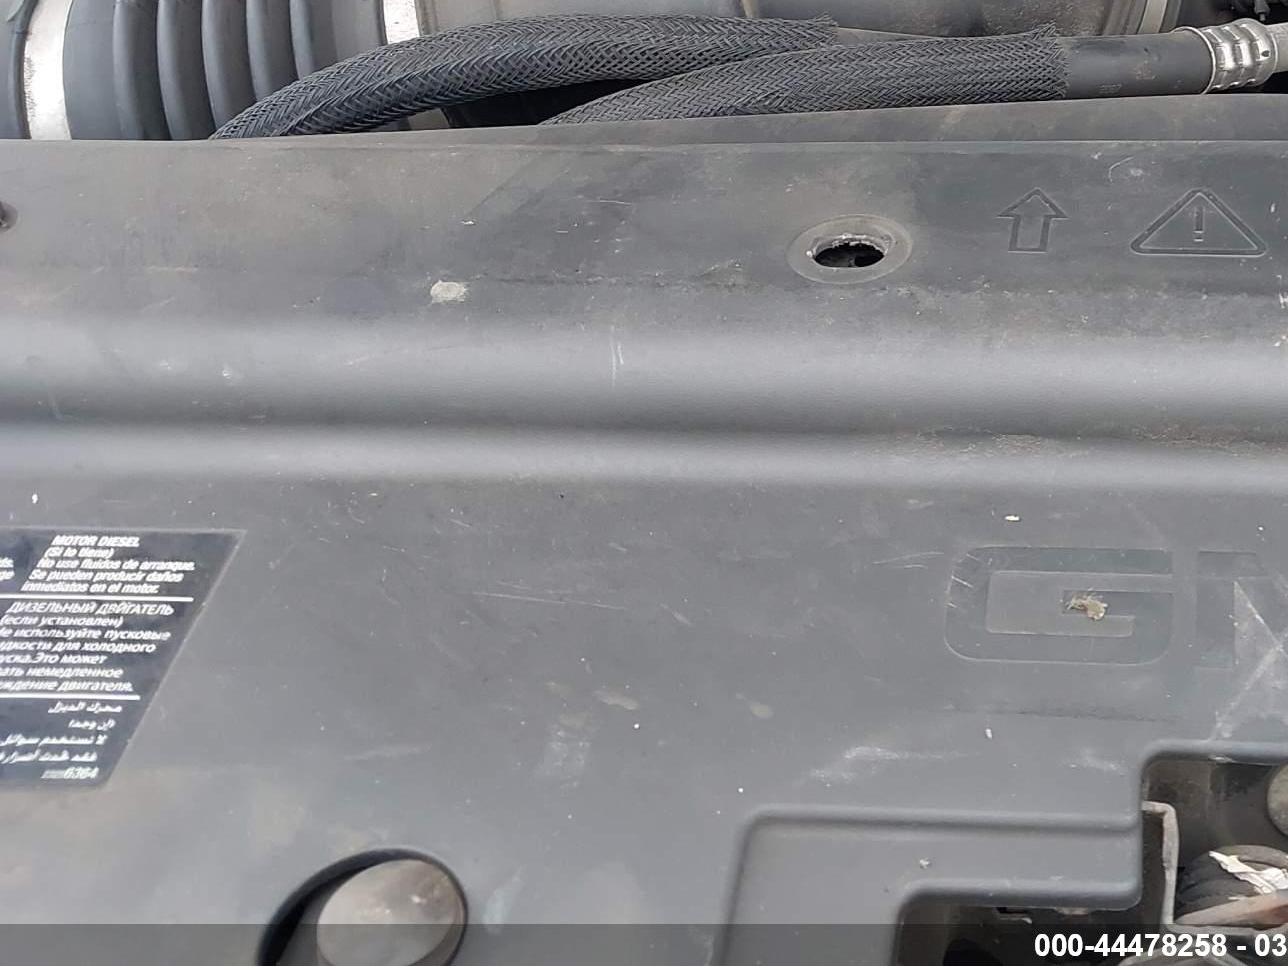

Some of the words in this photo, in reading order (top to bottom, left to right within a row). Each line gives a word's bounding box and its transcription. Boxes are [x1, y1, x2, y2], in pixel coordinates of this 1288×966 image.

[51, 534, 98, 546] MOTOR
[97, 535, 140, 547] DIESEL
[36, 558, 54, 568] No
[55, 560, 79, 569] use
[79, 559, 121, 570] fluidos
[122, 560, 139, 570] de
[28, 569, 46, 580] Se
[46, 570, 94, 582] pueden
[93, 571, 146, 583] producir
[20, 581, 89, 592] inmediatos
[89, 583, 105, 593] en
[107, 582, 119, 593] el
[5, 601, 96, 614] ДИЗЕЛЬНЫЙ
[39, 615, 124, 628] установлен)
[13, 628, 101, 640] используйте
[104, 629, 171, 641] пусковые
[52, 641, 81, 652] для
[81, 642, 157, 653] холодного
[60, 654, 108, 664] может
[26, 668, 123, 679] немедленное
